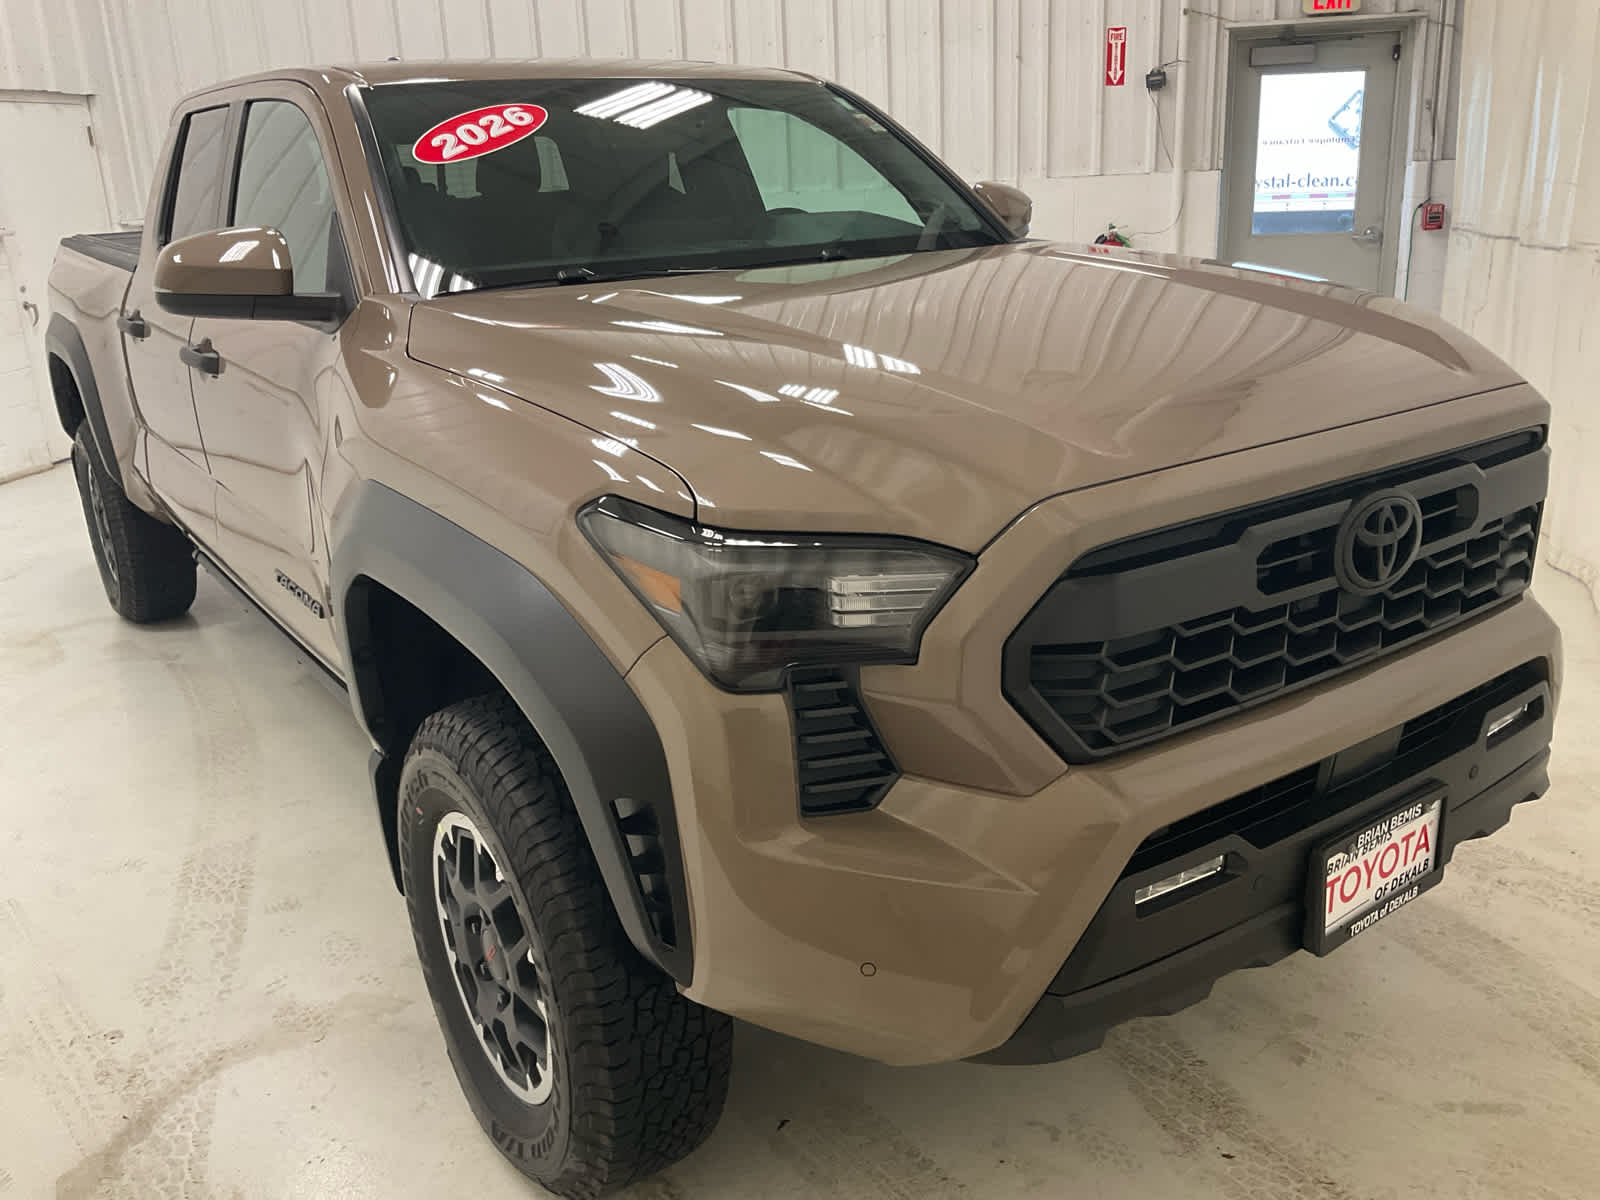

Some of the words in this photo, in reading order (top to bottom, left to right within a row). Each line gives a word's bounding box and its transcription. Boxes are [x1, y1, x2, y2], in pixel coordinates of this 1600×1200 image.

[431, 106, 534, 160] 2026
[1357, 820, 1390, 850] BRIAN
[1390, 803, 1423, 831] BEMIS
[1326, 823, 1430, 914] TOYOTA
[1374, 882, 1390, 901] OF
[1391, 858, 1429, 892] DEKALB
[1350, 909, 1379, 937] TOYOTA
[1388, 885, 1419, 913] DEKALB
